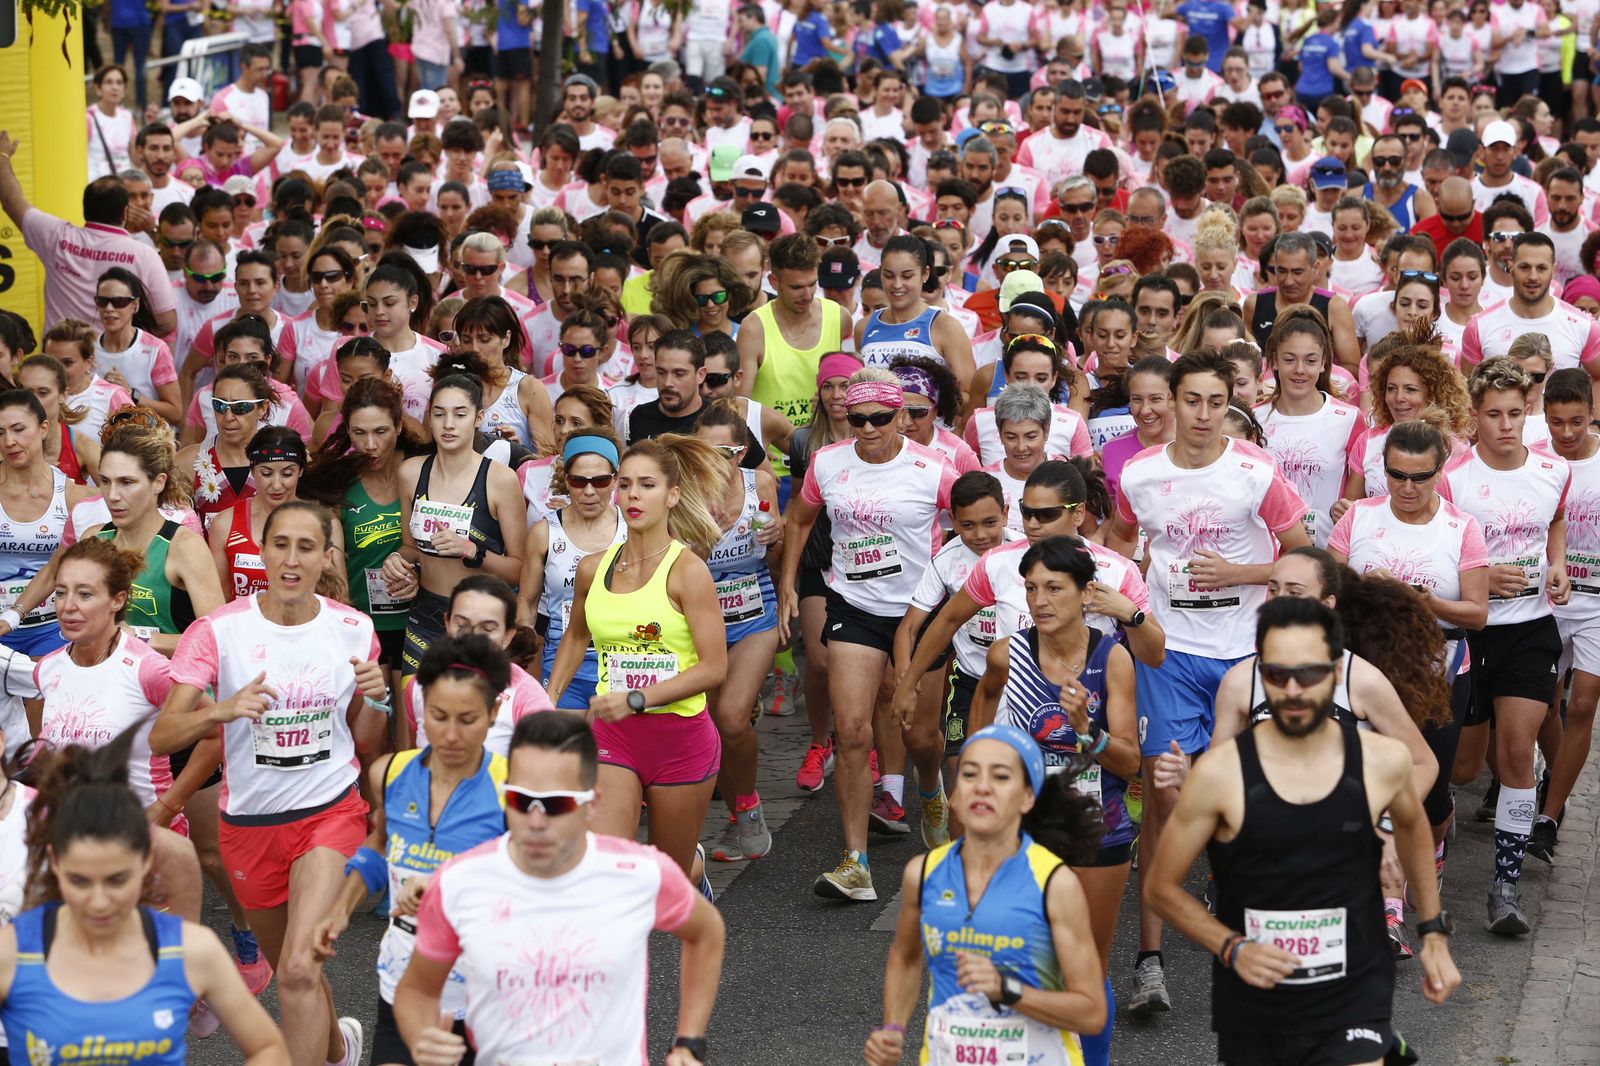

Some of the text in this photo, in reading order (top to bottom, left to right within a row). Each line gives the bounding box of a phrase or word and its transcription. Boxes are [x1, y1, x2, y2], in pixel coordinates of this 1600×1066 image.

[60, 239, 135, 265] ORGANIZACIÓN
[420, 506, 470, 520] COVIRAN
[848, 535, 893, 549] COVIRAN
[854, 549, 881, 566] 8759
[620, 660, 676, 670] COVIRAN
[265, 710, 331, 726] COVIRAN
[275, 728, 310, 748] 5772
[1265, 916, 1342, 931] COVIRAN
[946, 926, 1025, 952] olimpo
[949, 1024, 1025, 1039] COVIRAN
[59, 1034, 173, 1061] olimpo
[955, 1043, 999, 1065] 8374
